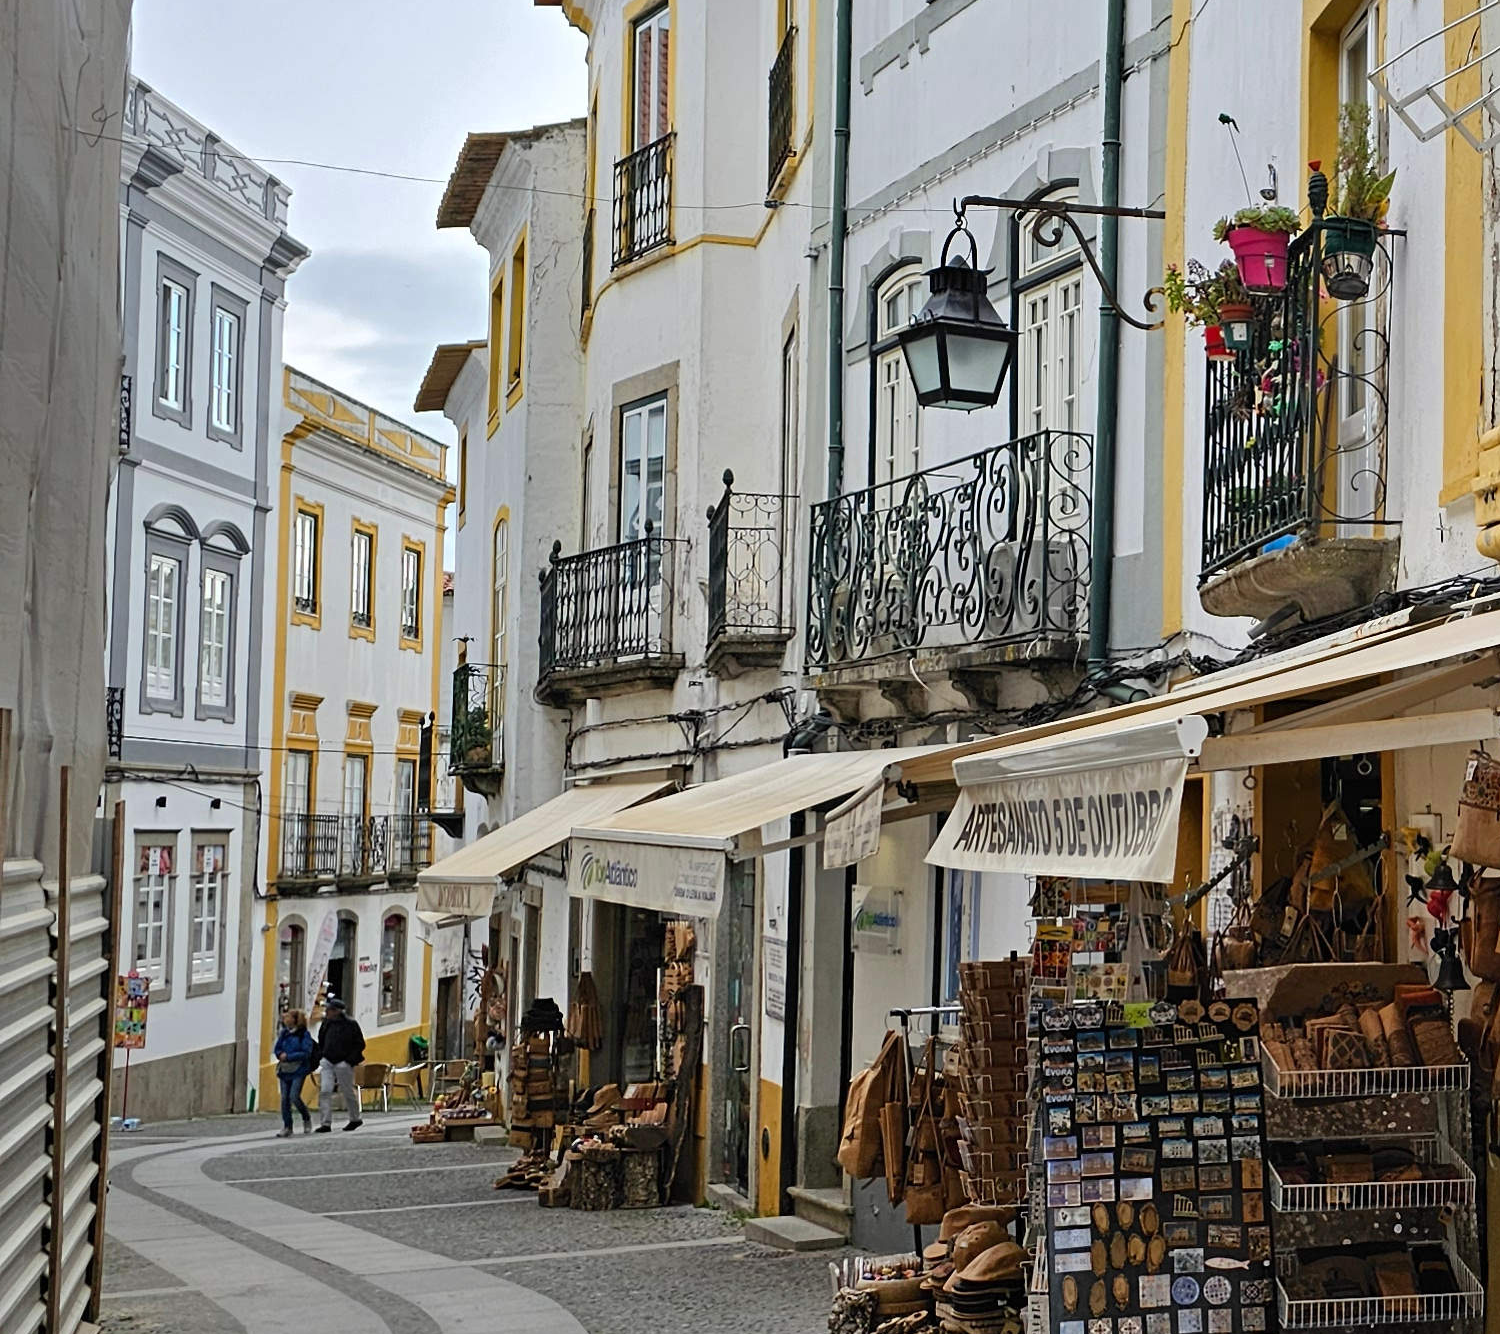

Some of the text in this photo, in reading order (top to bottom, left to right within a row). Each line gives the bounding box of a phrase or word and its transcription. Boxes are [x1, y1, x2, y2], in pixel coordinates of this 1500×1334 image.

[953, 798, 1050, 856] ARTESANATO
[1053, 798, 1064, 857] 5
[1064, 796, 1087, 857] DE
[1088, 786, 1174, 859] OUTUBRO
